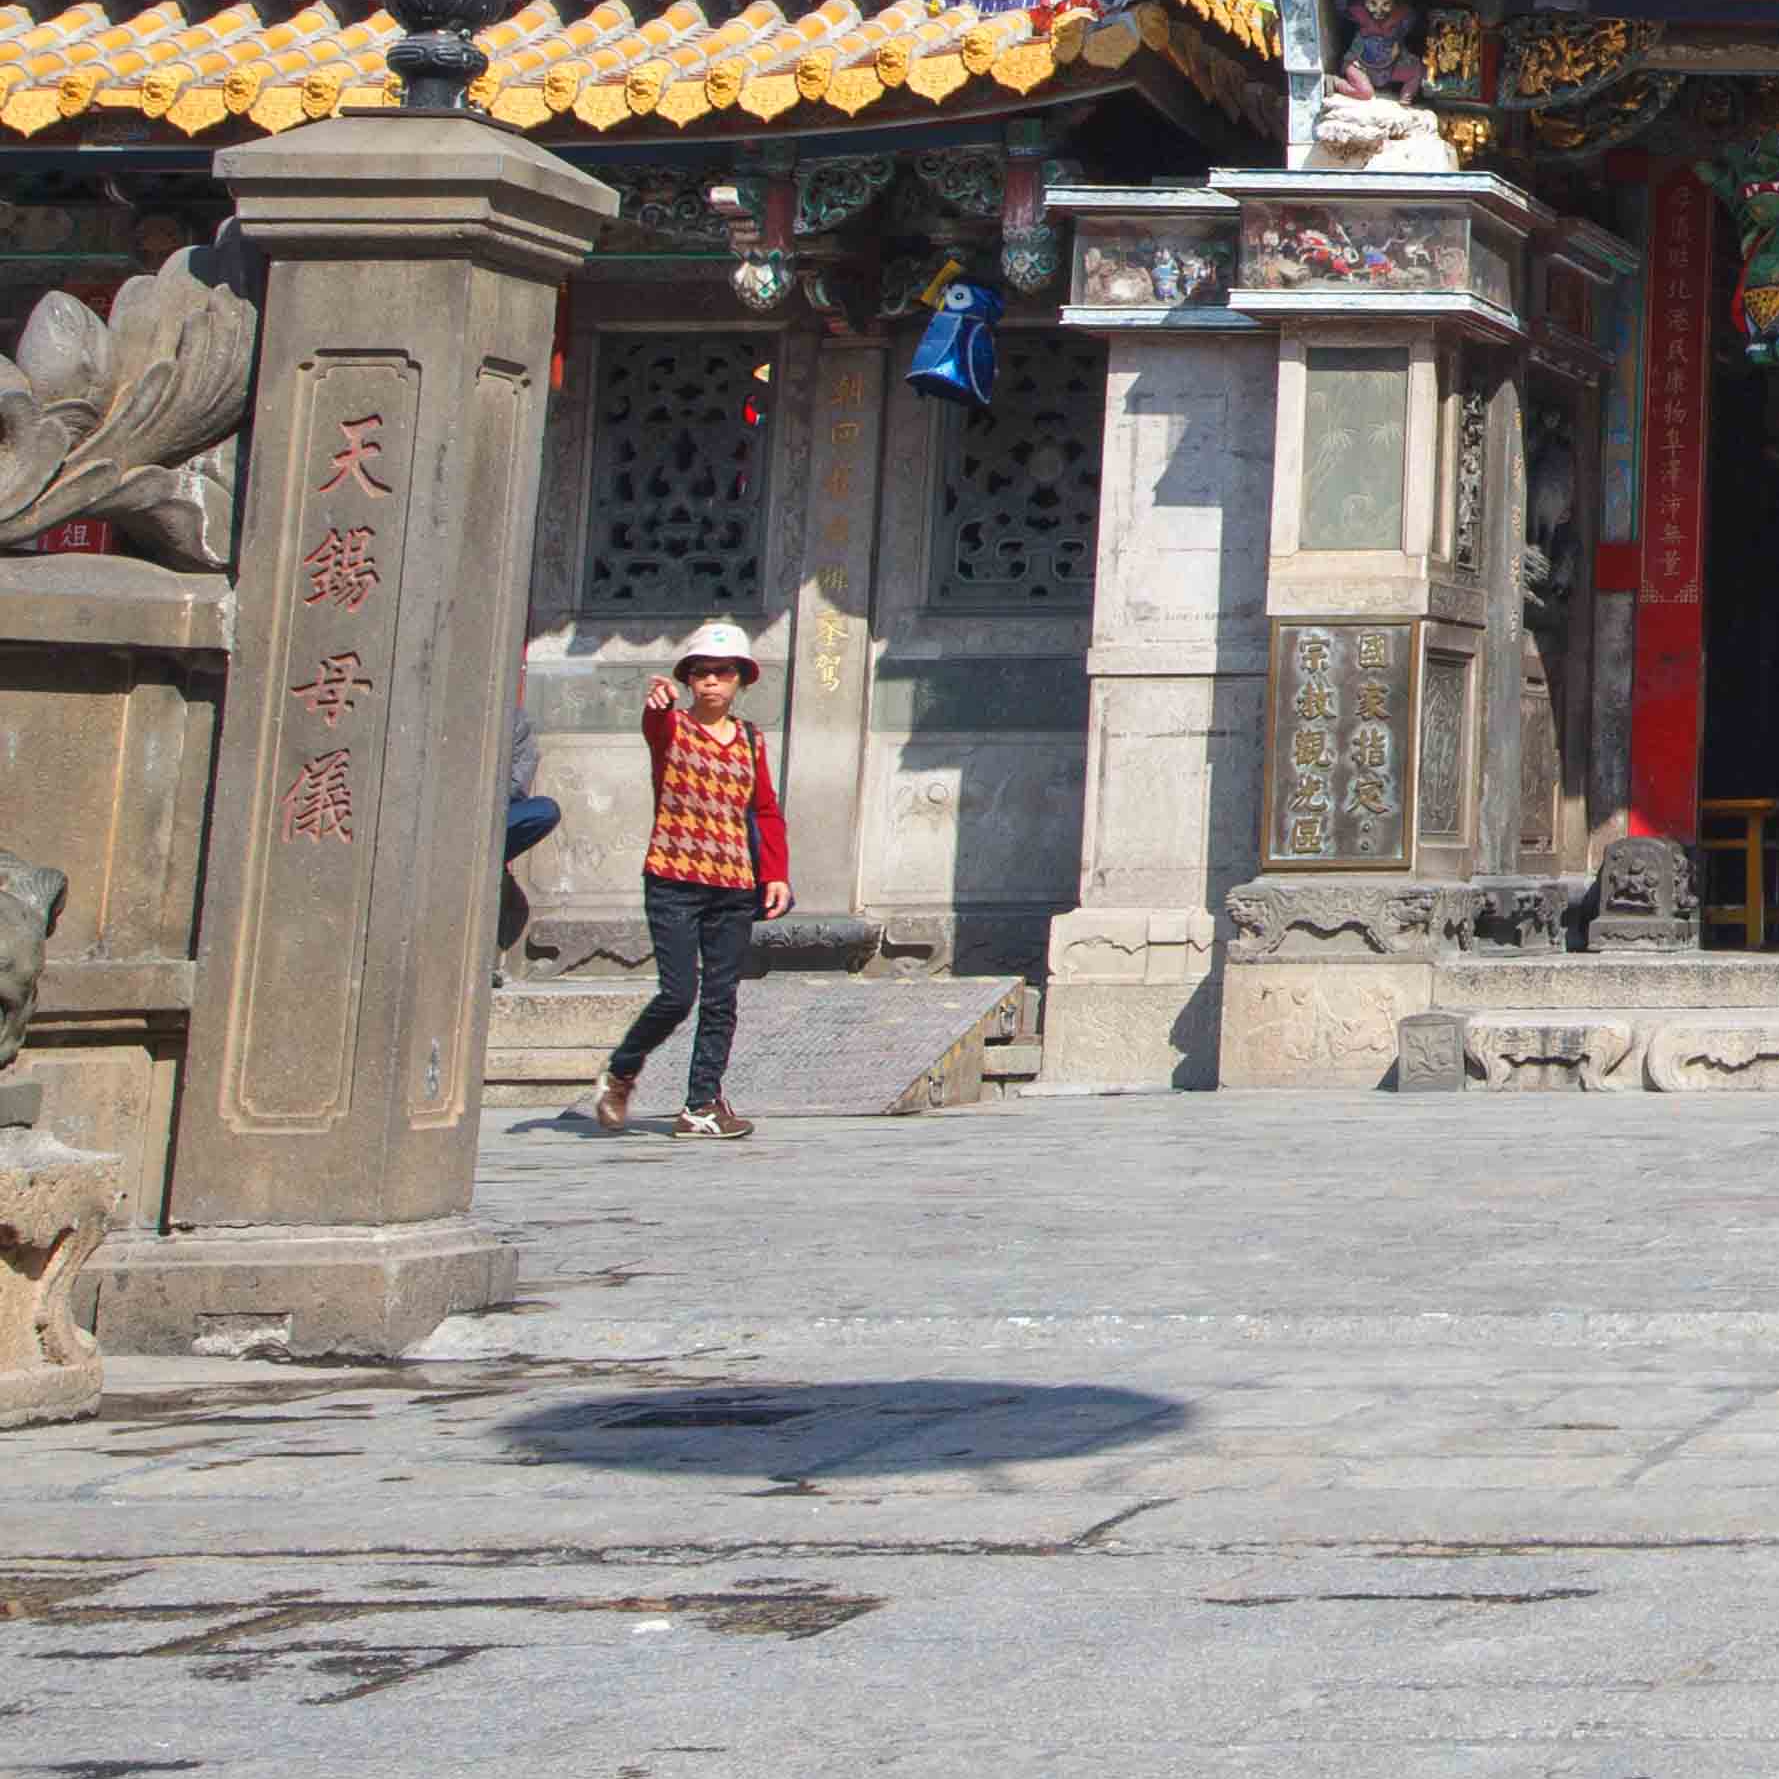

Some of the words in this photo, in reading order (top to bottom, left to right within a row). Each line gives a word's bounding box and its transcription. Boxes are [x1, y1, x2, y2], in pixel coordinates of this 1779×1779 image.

[278, 413, 393, 846] 天錫母儀
[1290, 633, 1337, 854] 宗教觀光區
